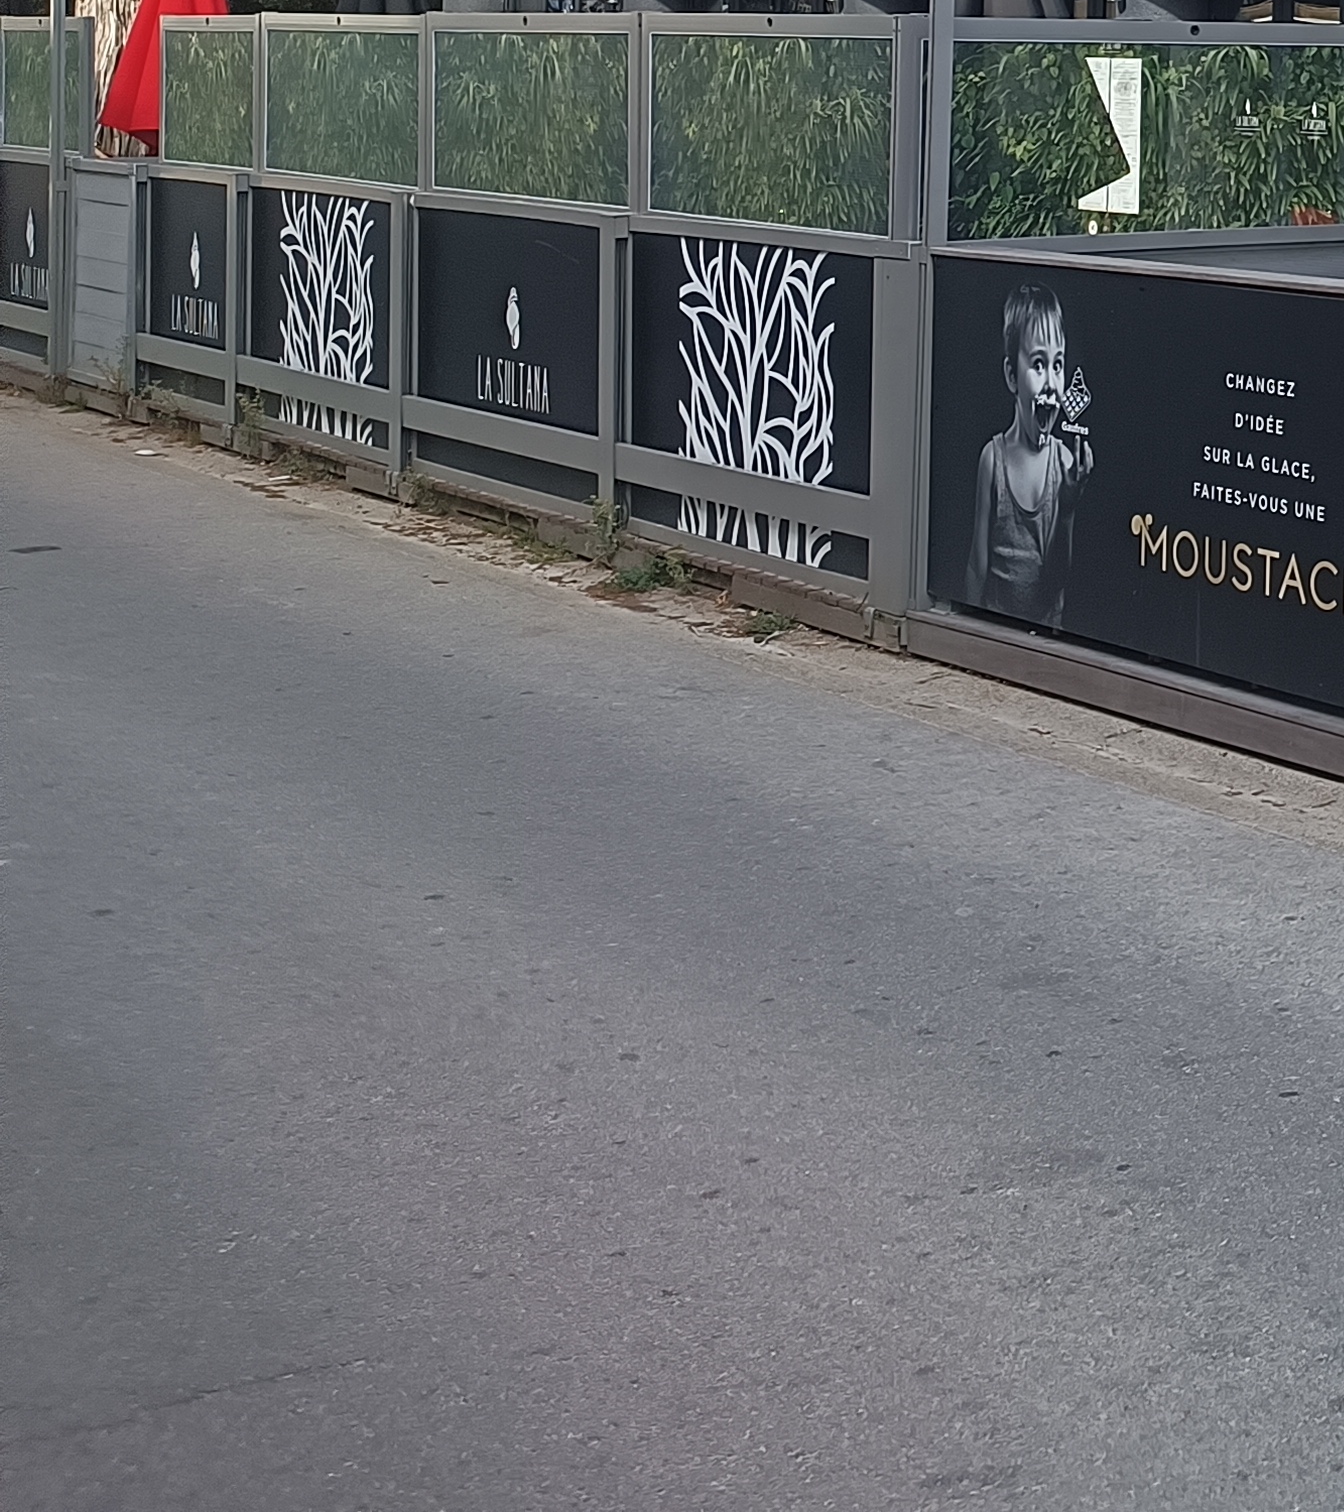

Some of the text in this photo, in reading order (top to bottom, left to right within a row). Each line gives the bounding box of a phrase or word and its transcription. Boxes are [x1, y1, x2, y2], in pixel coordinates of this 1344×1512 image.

[171, 294, 219, 340] LA SULTANA
[477, 354, 549, 414] LA SULTANA
[1225, 372, 1296, 398] CHANGEZ
[1234, 411, 1285, 435] D'IDÉE
[1203, 445, 1316, 483] SUR LA GLACE,
[1192, 481, 1326, 522] FAITES-VOUS UNE
